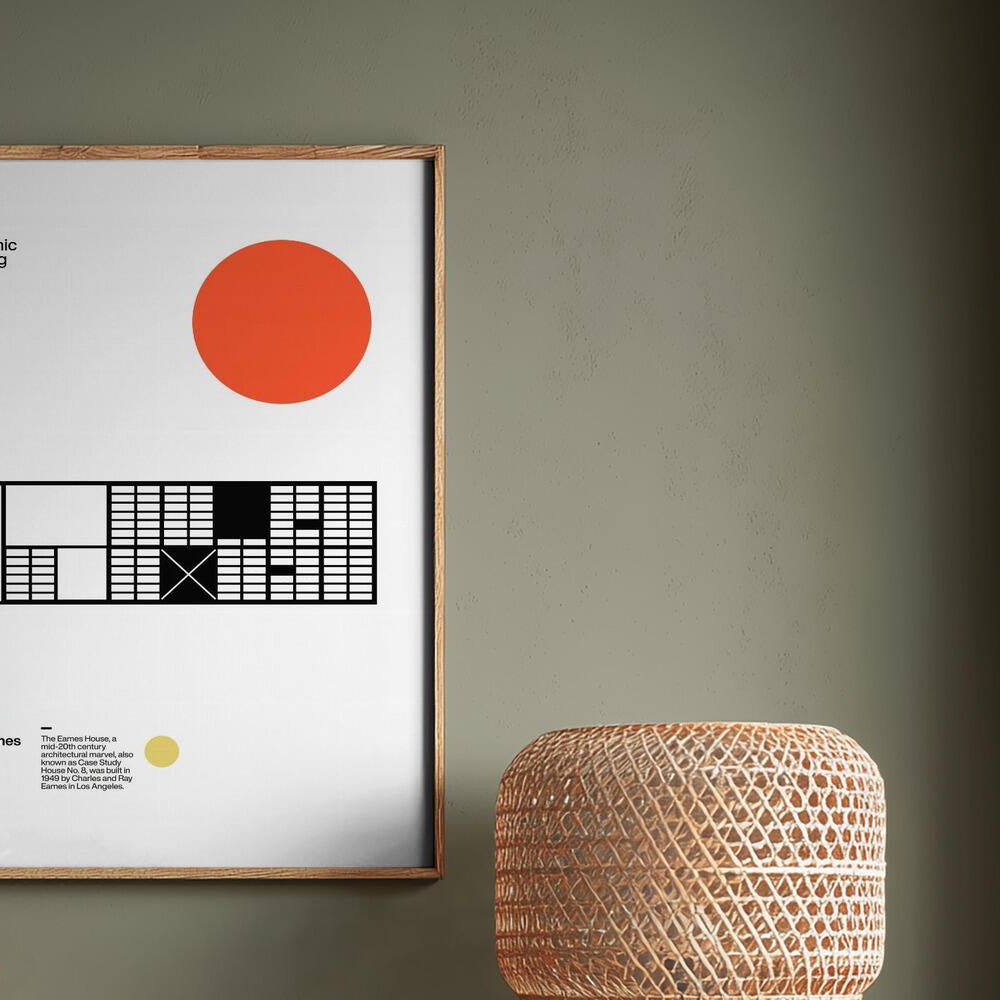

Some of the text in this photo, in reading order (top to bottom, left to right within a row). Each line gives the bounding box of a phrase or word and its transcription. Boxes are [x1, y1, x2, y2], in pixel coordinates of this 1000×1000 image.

[84, 735, 111, 743] House,
[89, 751, 117, 759] marvel,
[99, 759, 122, 767] Study
[80, 767, 89, 775] 8,
[61, 775, 71, 783] by
[118, 775, 133, 783] Ray
[92, 783, 125, 791] Angeles.
